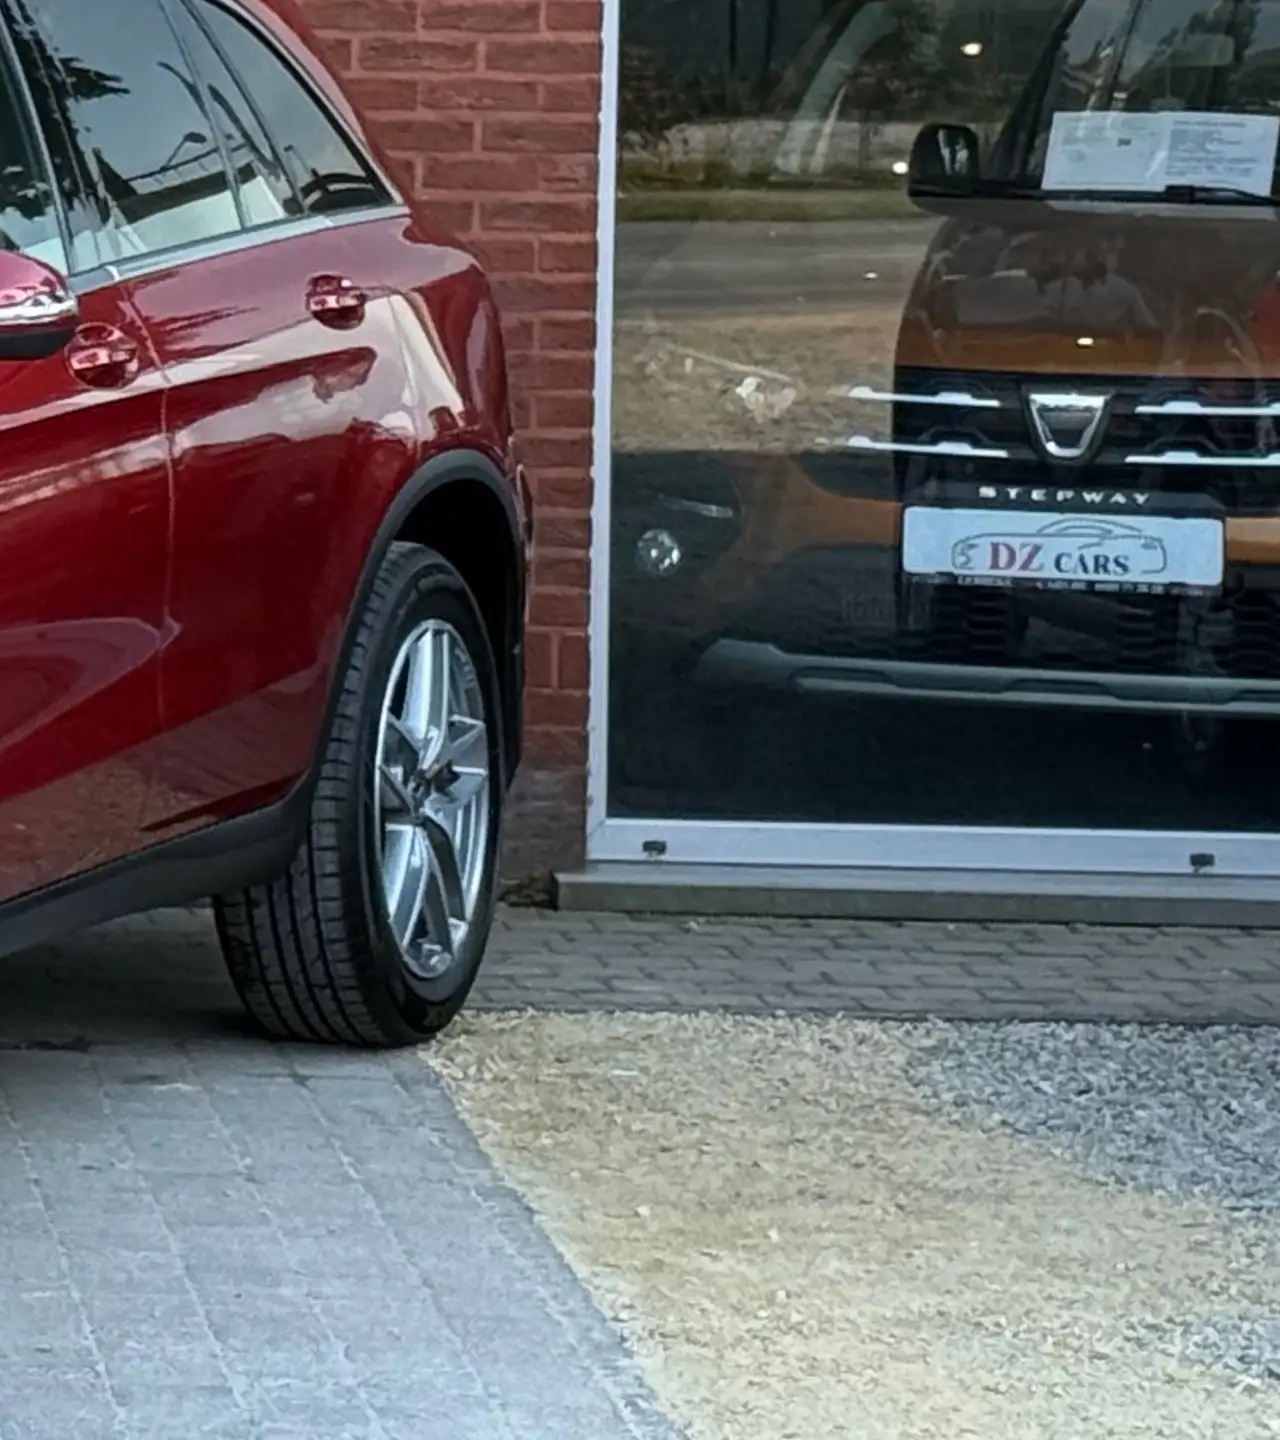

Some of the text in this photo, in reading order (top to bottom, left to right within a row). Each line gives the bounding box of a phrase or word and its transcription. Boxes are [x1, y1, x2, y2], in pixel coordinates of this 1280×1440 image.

[978, 485, 1151, 505] STEPWAY
[988, 541, 1131, 576] DZ CARS
